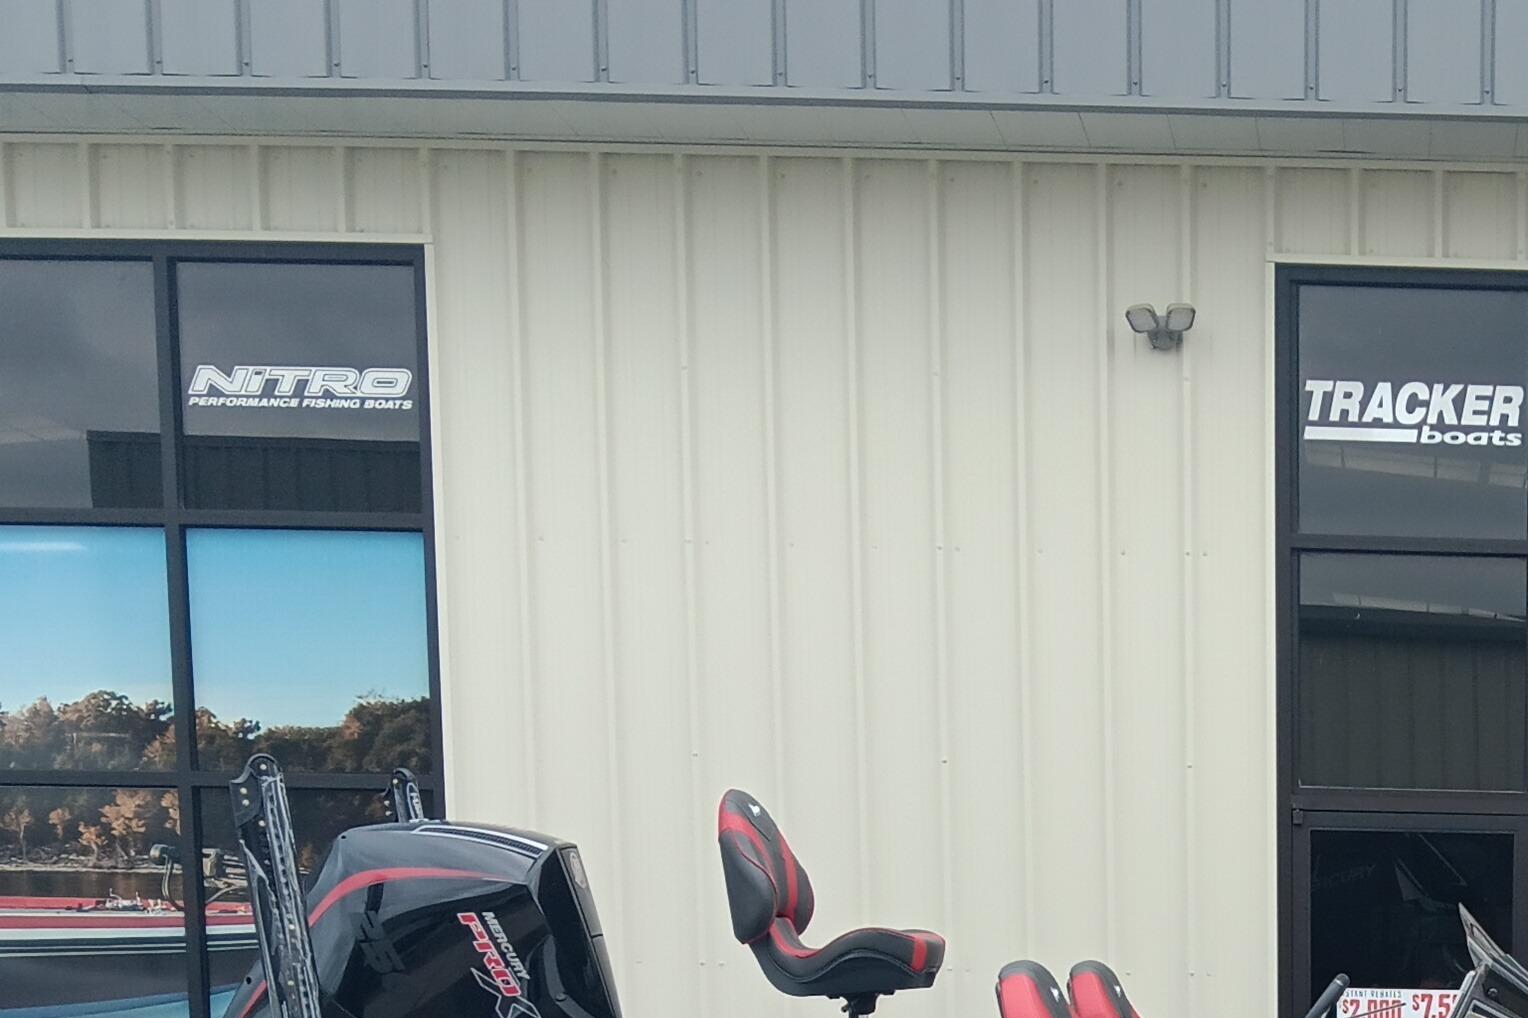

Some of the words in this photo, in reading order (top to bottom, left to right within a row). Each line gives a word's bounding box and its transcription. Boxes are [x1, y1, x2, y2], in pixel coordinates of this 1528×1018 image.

[188, 397, 299, 408] PERFORMANCE
[302, 398, 360, 409] FISHING
[363, 400, 413, 410] BOATS
[1304, 379, 1525, 427] TRACKER
[1420, 425, 1522, 446] boats
[456, 911, 522, 997] PRO
[481, 911, 531, 980] MERCURY
